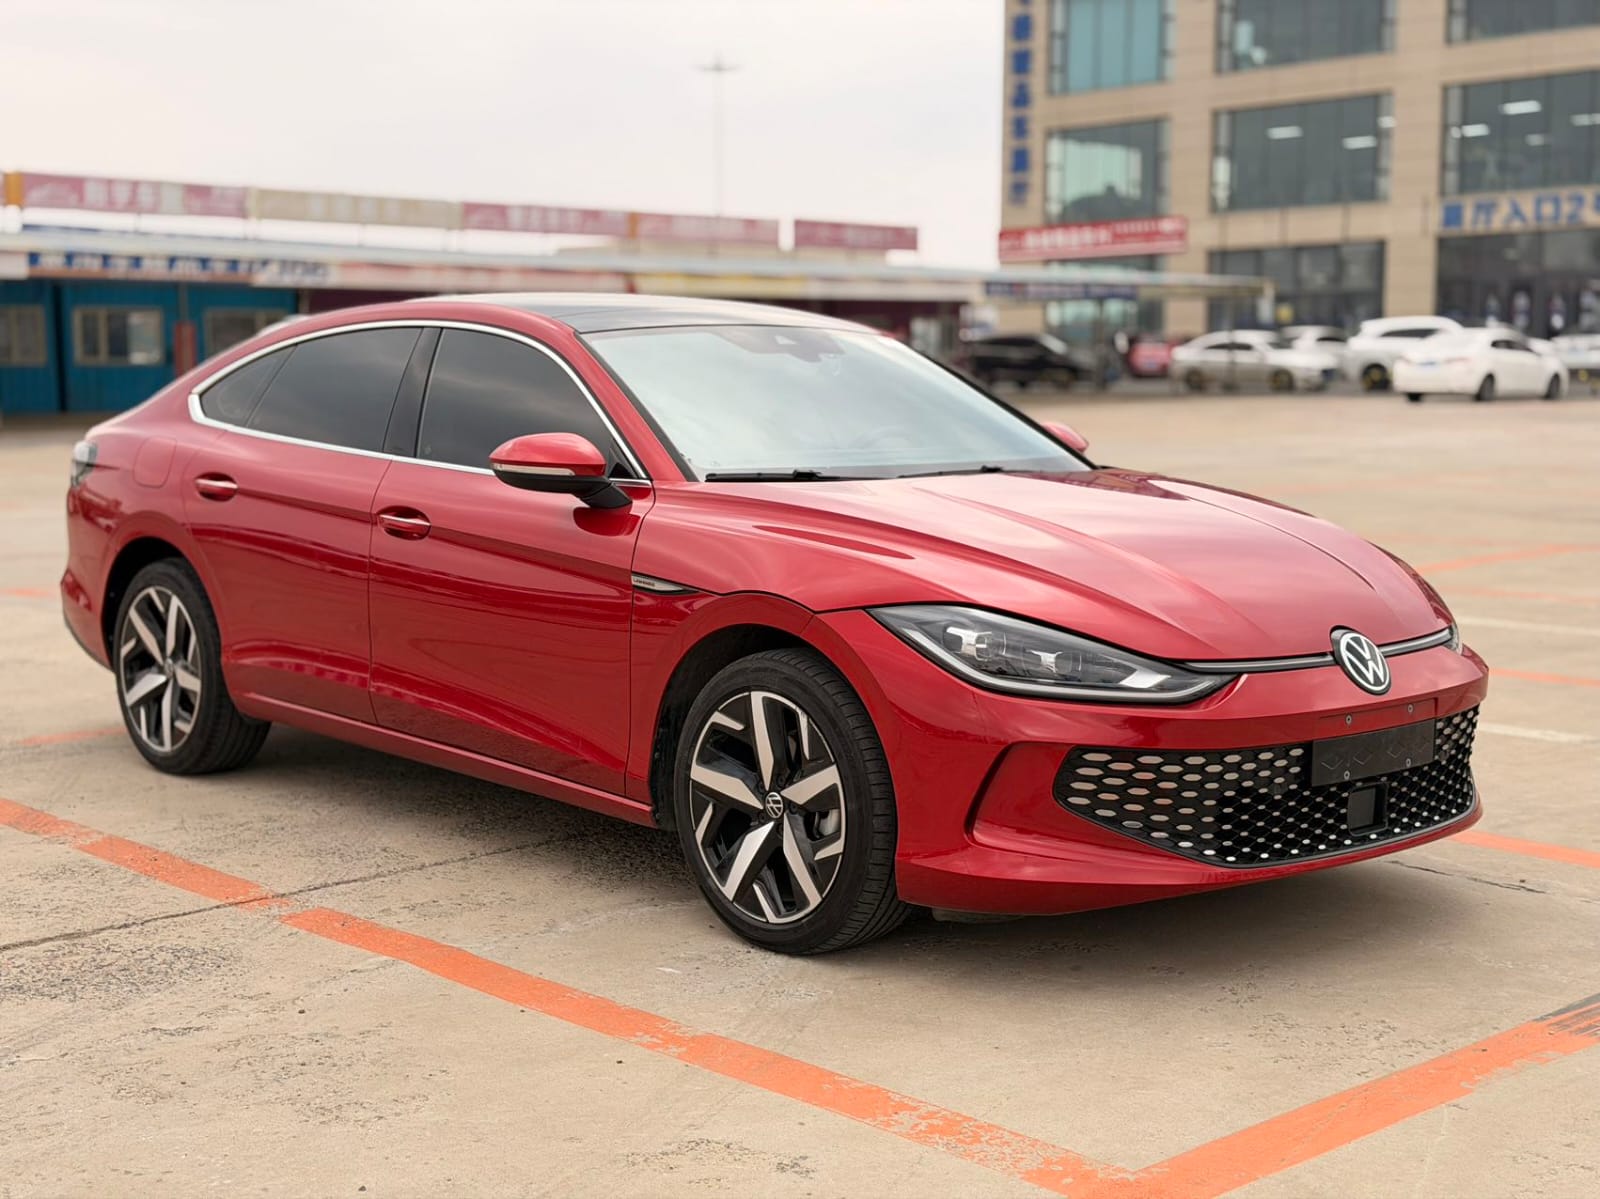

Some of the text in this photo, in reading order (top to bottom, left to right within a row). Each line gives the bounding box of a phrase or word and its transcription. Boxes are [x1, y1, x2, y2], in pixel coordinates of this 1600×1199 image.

[1442, 192, 1600, 228] 厅入口2
[1339, 632, 1390, 691] VW
